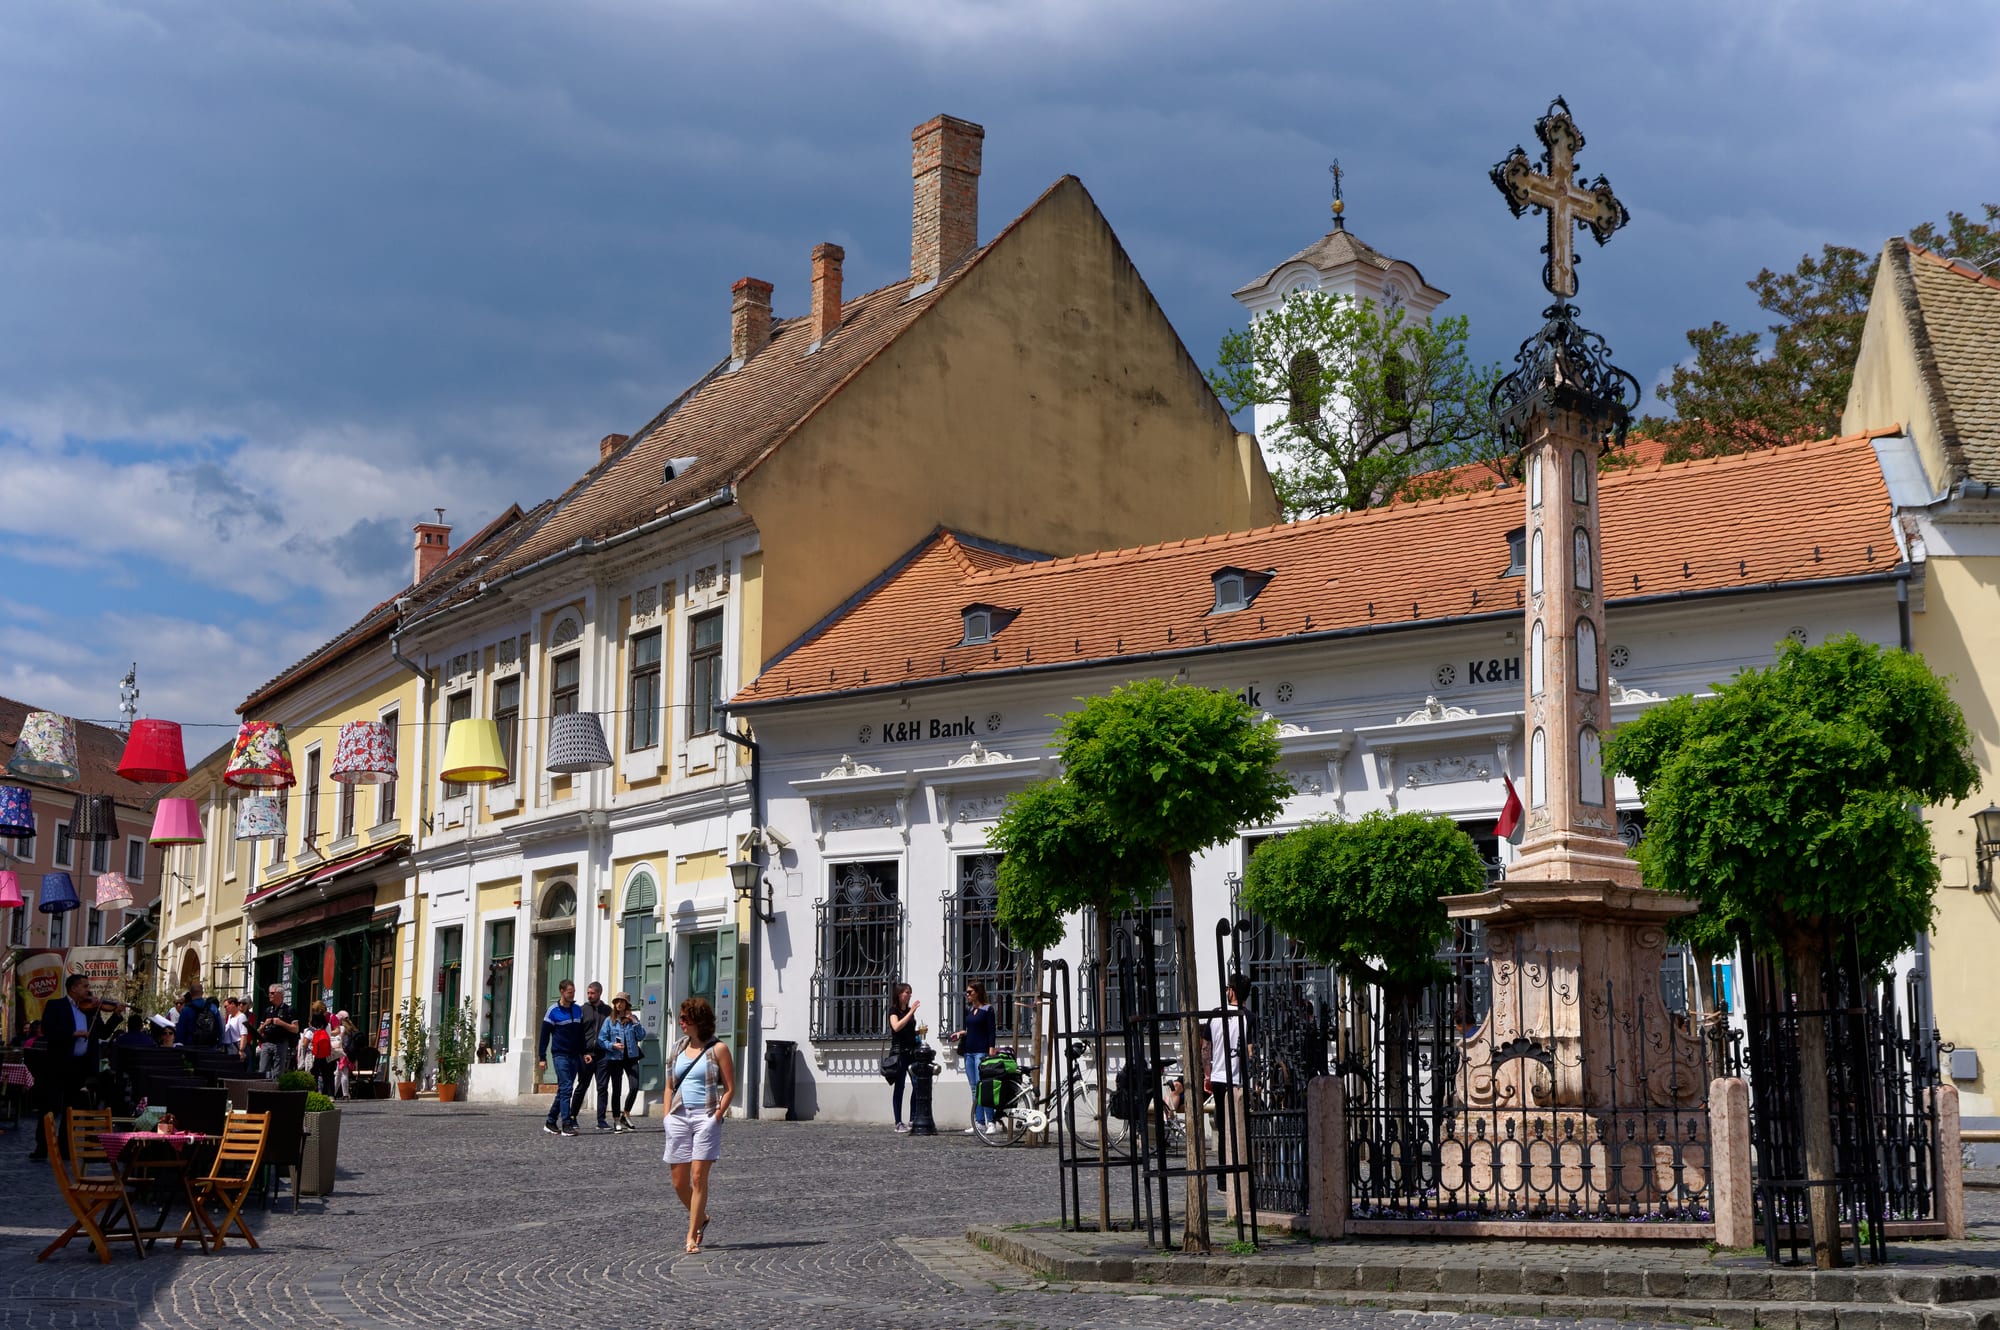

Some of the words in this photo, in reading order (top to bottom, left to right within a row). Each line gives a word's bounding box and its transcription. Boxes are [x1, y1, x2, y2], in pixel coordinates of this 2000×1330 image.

[1469, 657, 1520, 684] K&H
[883, 720, 920, 743] K&H
[929, 715, 975, 738] Bank
[29, 979, 57, 989] ARANY
